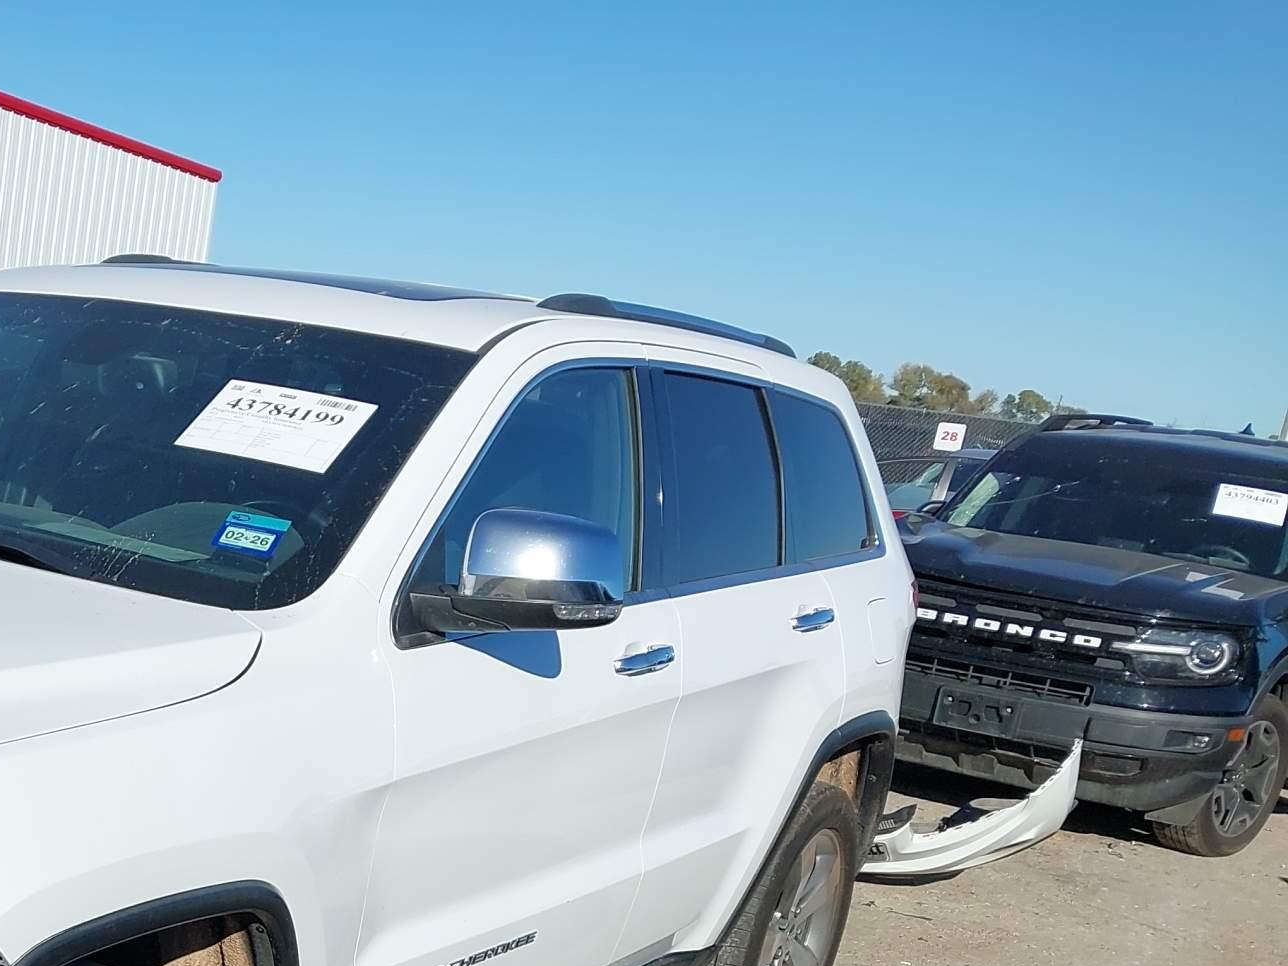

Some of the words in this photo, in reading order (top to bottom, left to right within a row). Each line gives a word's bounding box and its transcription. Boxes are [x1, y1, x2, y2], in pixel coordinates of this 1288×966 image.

[226, 396, 345, 427] 43784199
[940, 430, 959, 442] 28
[916, 606, 1103, 648] BRONCO
